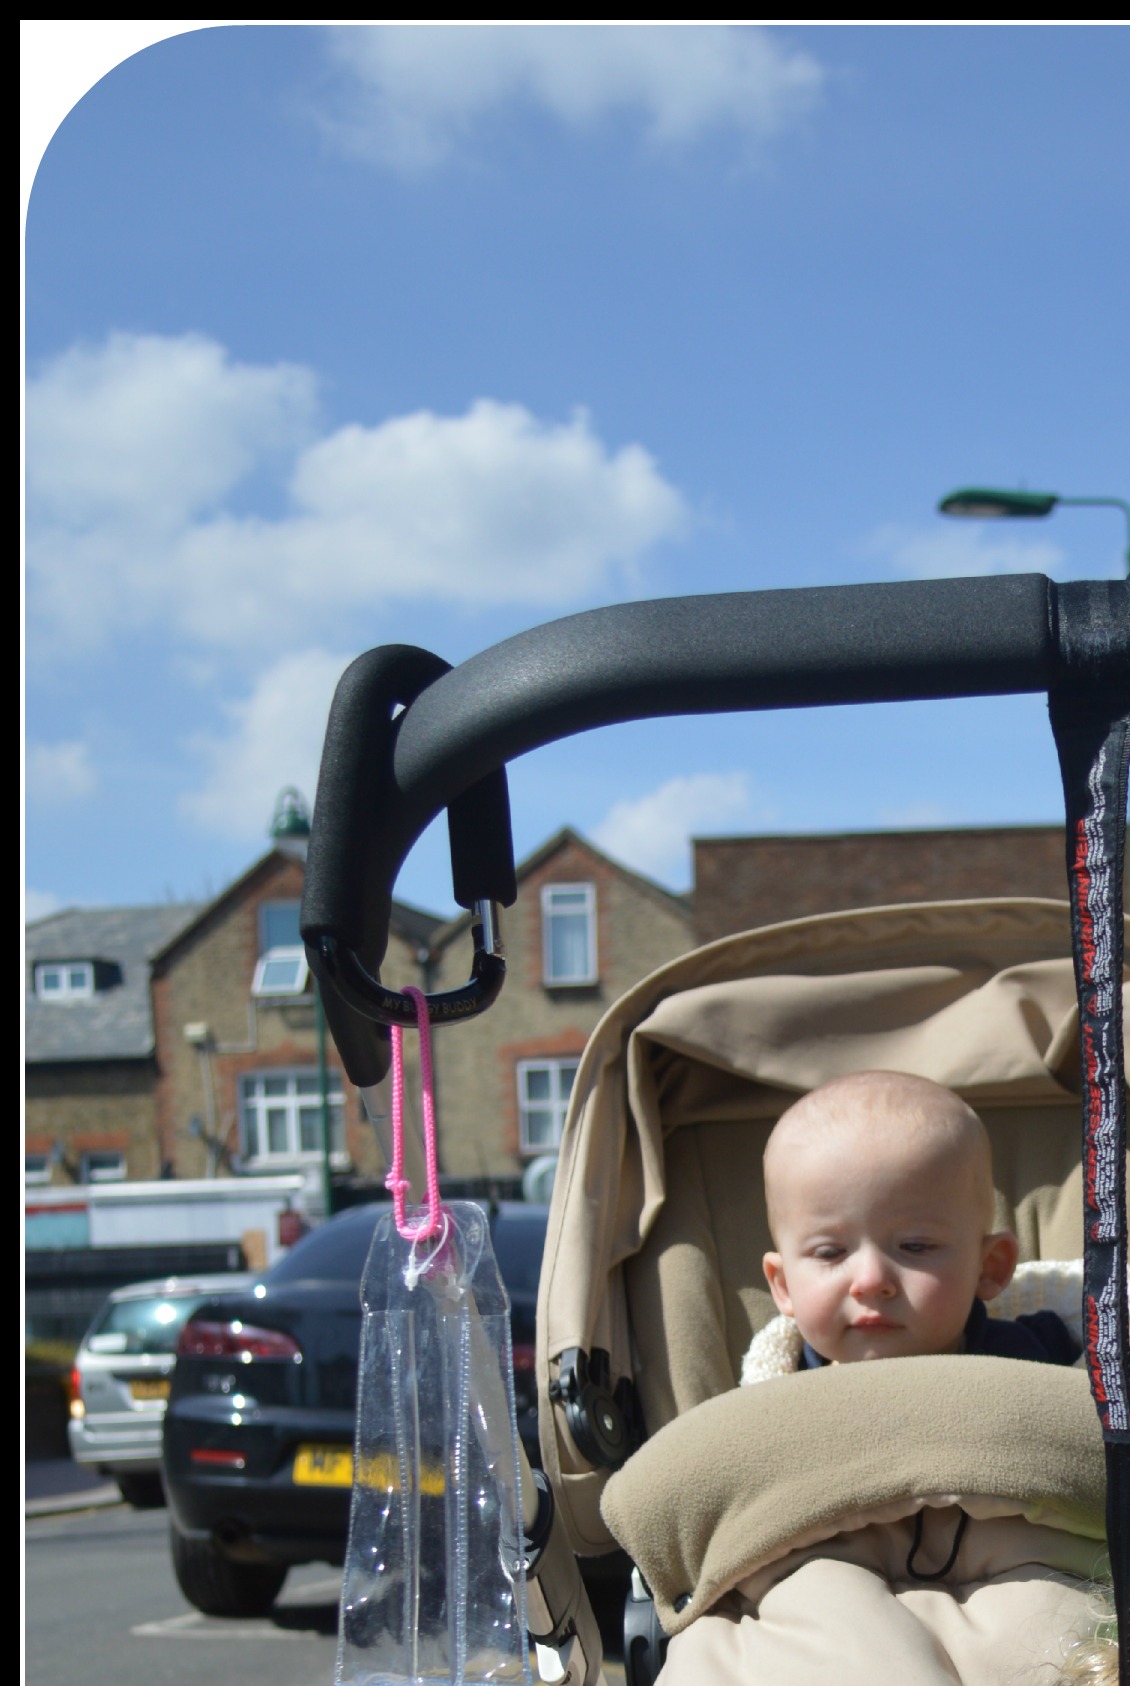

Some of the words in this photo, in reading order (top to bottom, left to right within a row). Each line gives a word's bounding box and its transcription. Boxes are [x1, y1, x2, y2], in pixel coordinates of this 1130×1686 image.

[382, 996, 400, 1009] MY
[403, 1001, 440, 1014] BUGY
[442, 998, 477, 1013] BUDDY
[1088, 1296, 1107, 1402] WARNING
